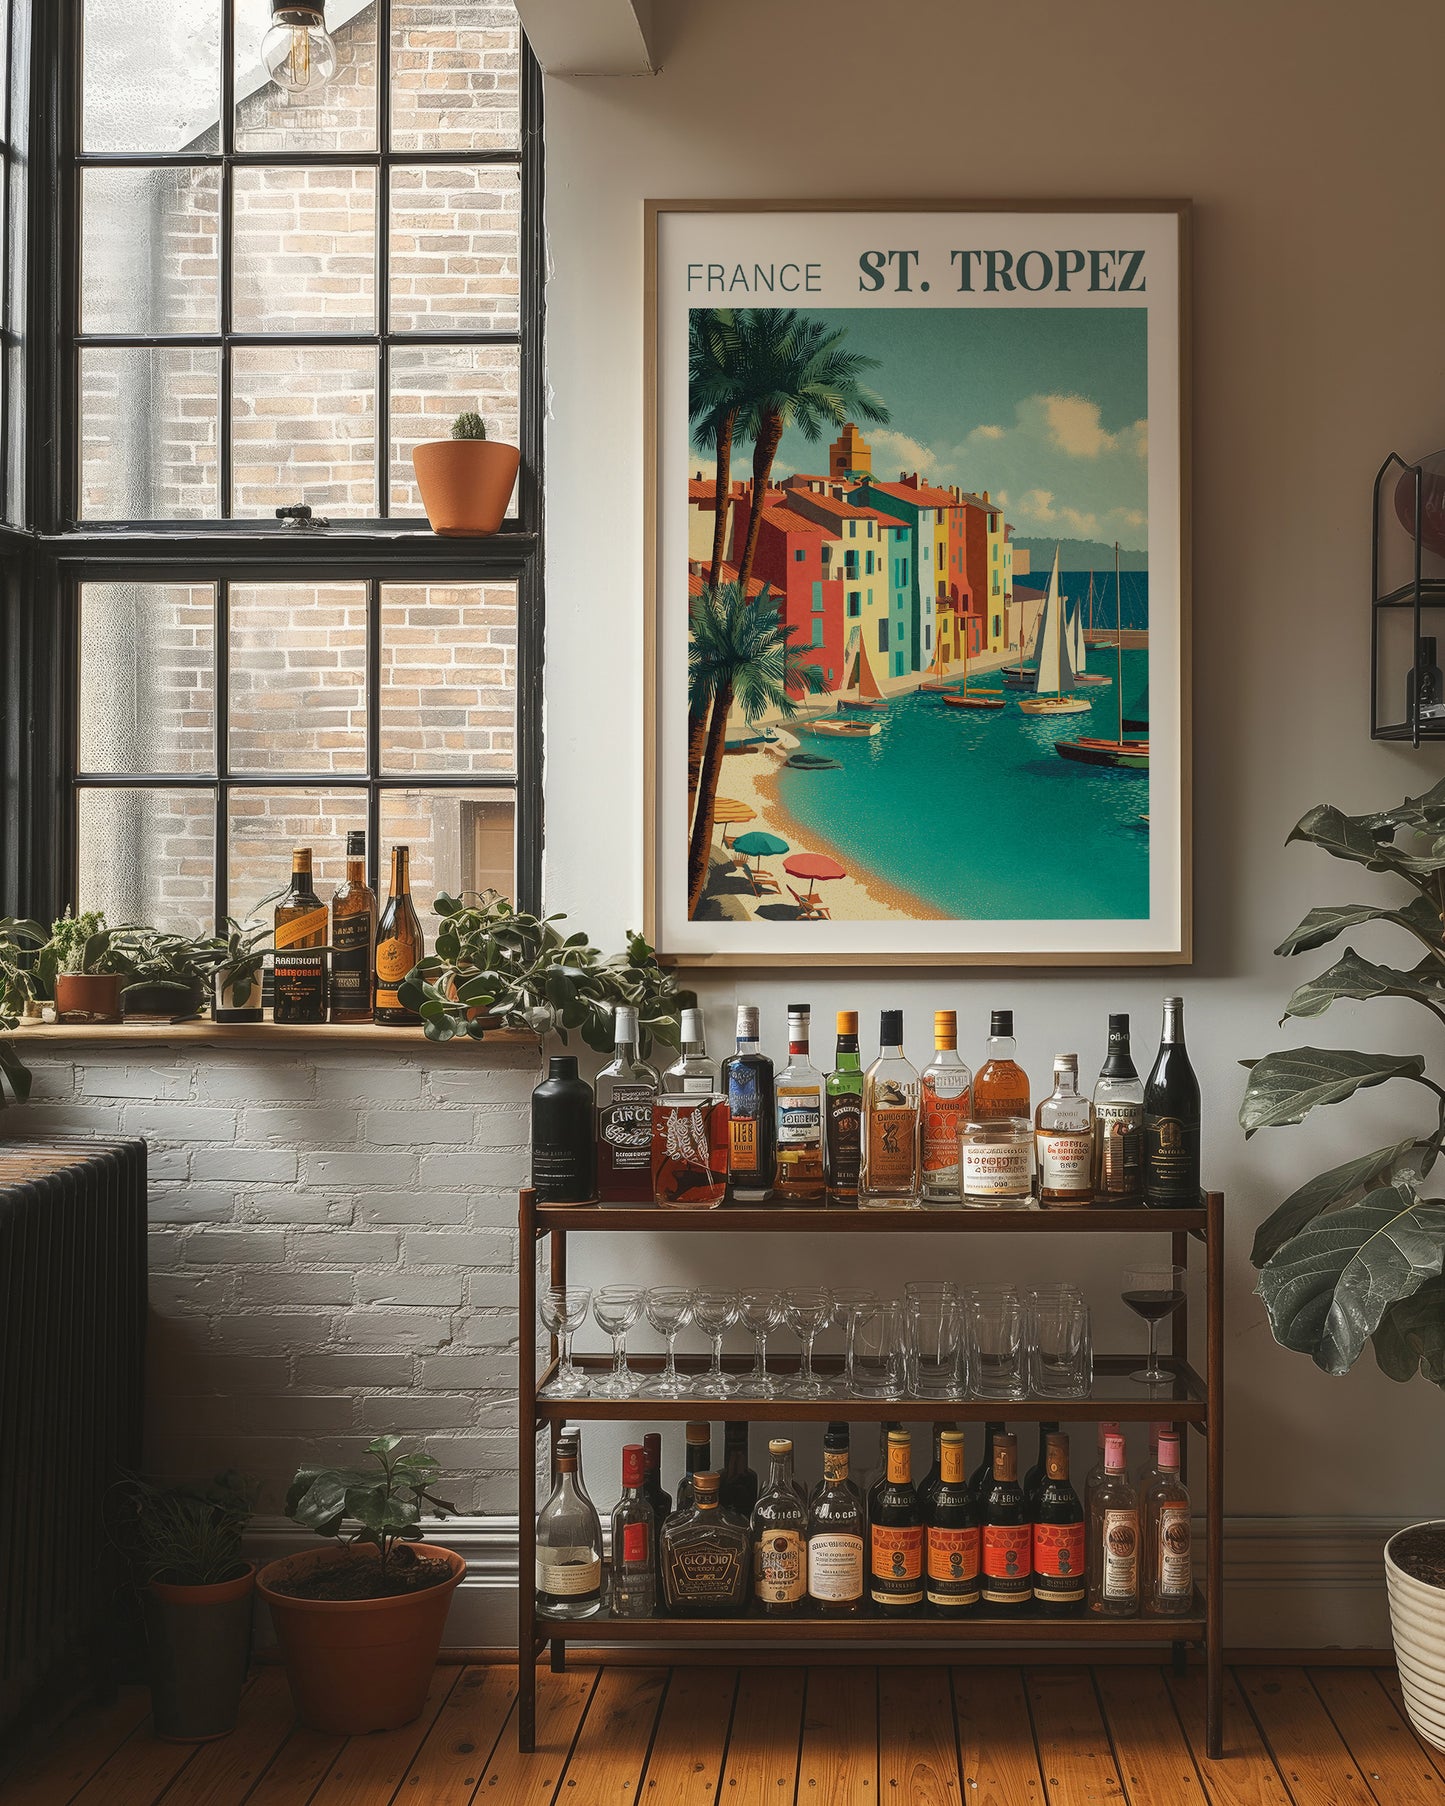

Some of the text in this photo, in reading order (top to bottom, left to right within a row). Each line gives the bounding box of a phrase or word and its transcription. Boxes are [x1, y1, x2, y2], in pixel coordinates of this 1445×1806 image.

[687, 250, 1147, 292] FRANCE ST. TROPEZ
